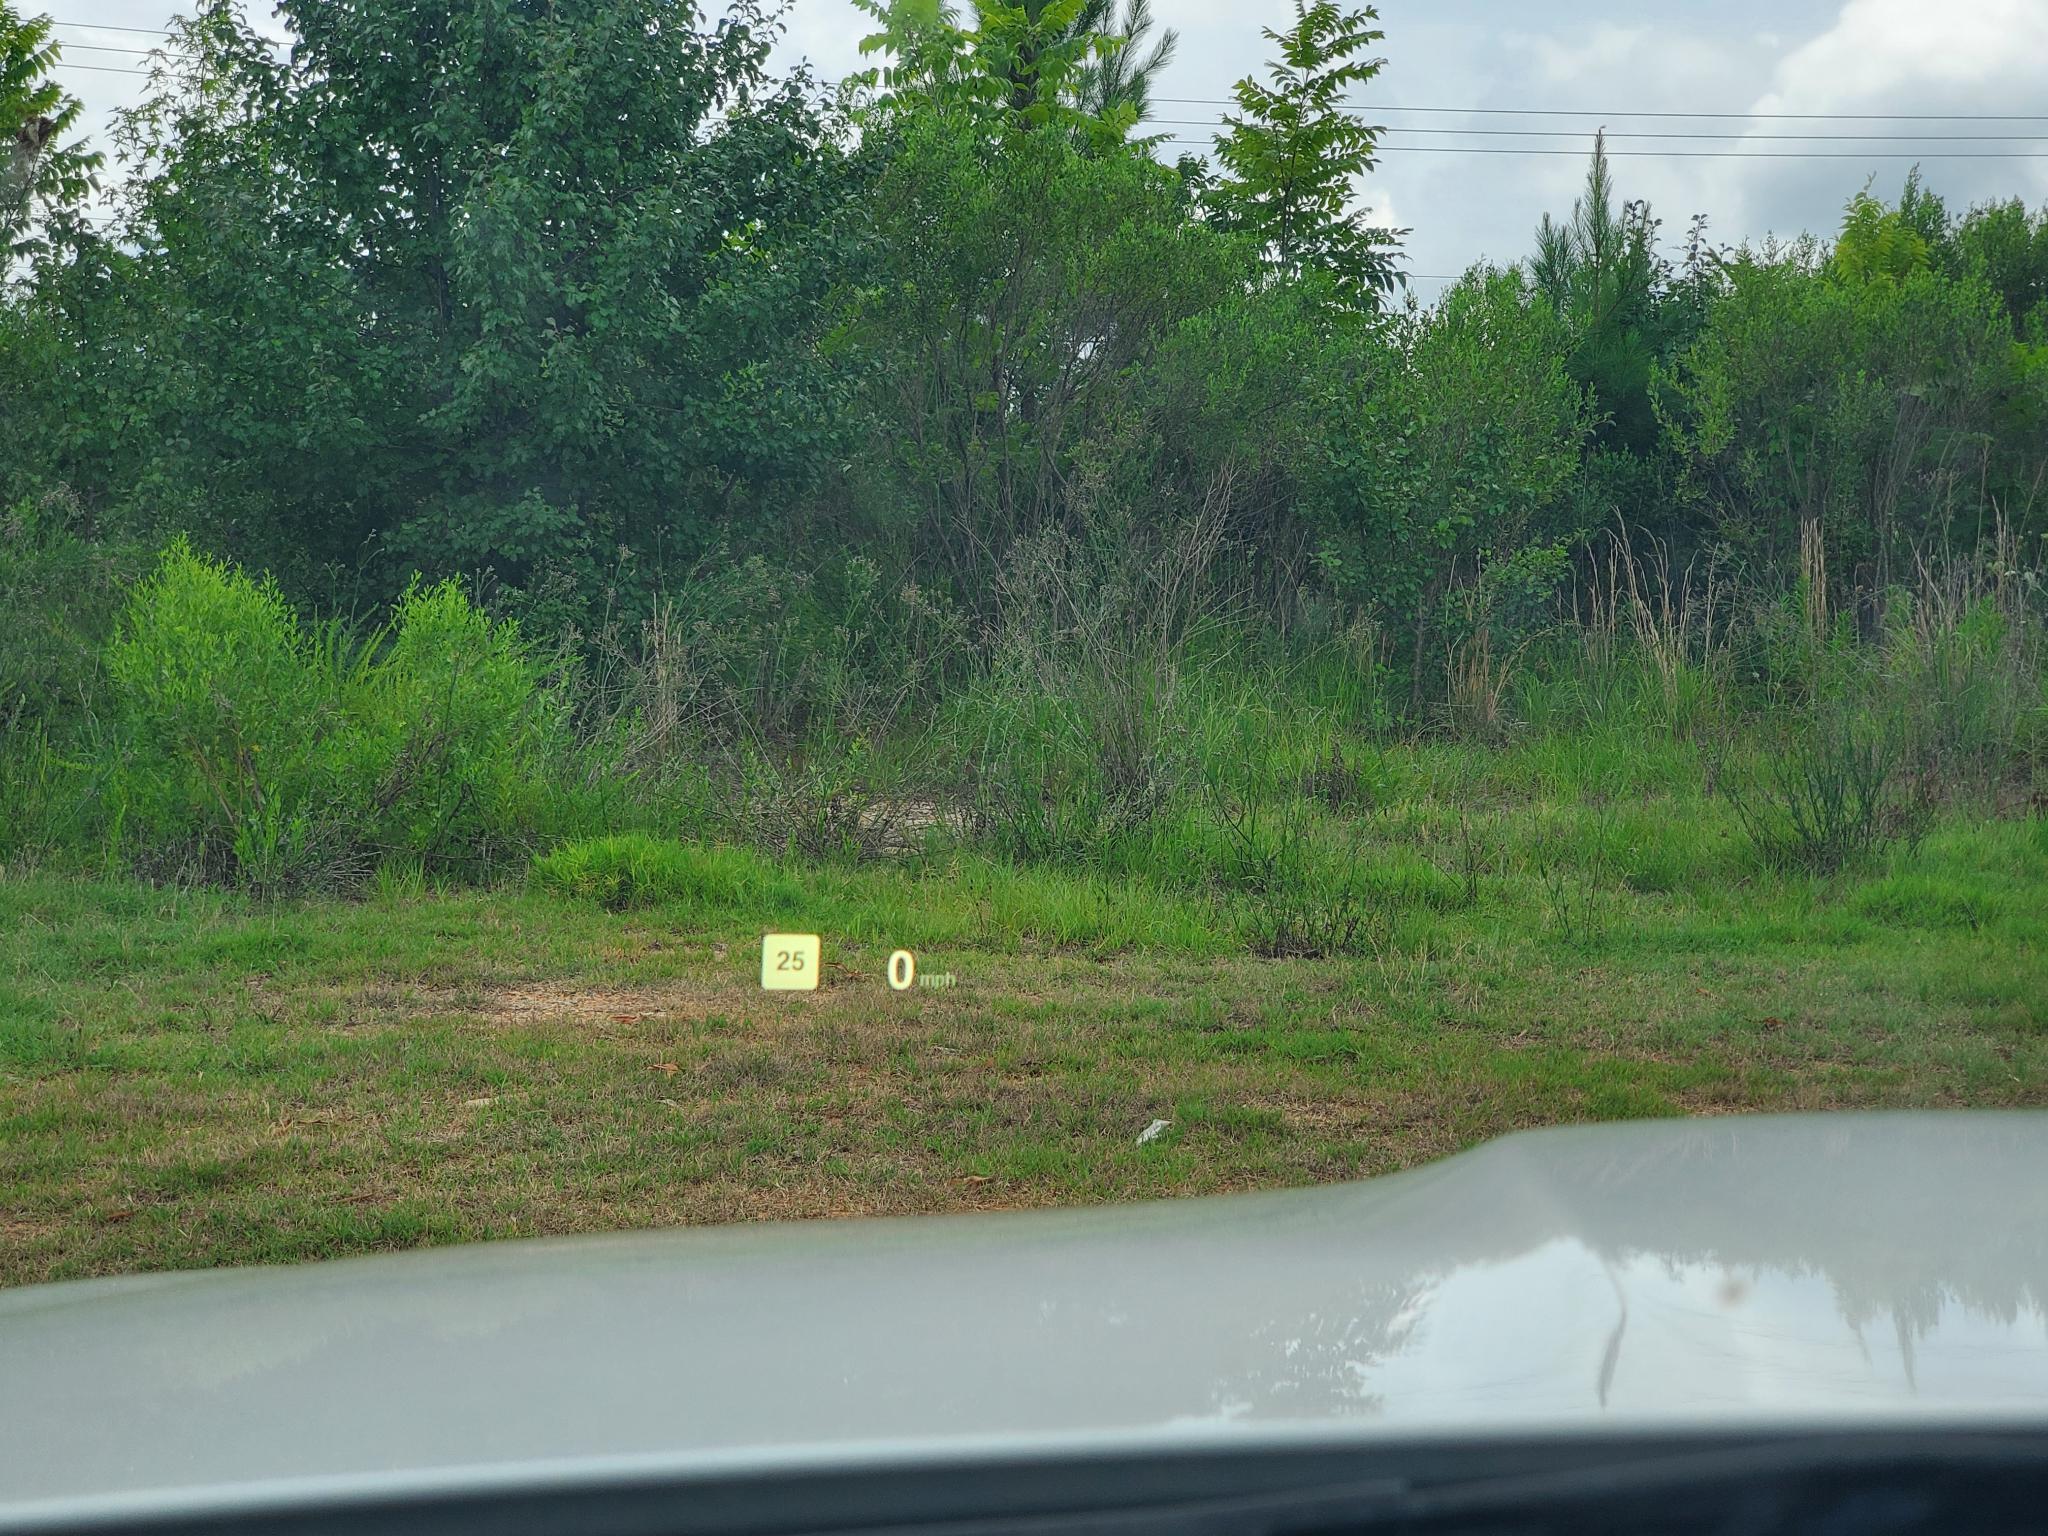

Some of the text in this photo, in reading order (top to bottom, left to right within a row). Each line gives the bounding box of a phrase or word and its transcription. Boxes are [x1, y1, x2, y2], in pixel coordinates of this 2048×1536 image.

[776, 951, 805, 971] 25
[887, 949, 957, 990] 0 mph
